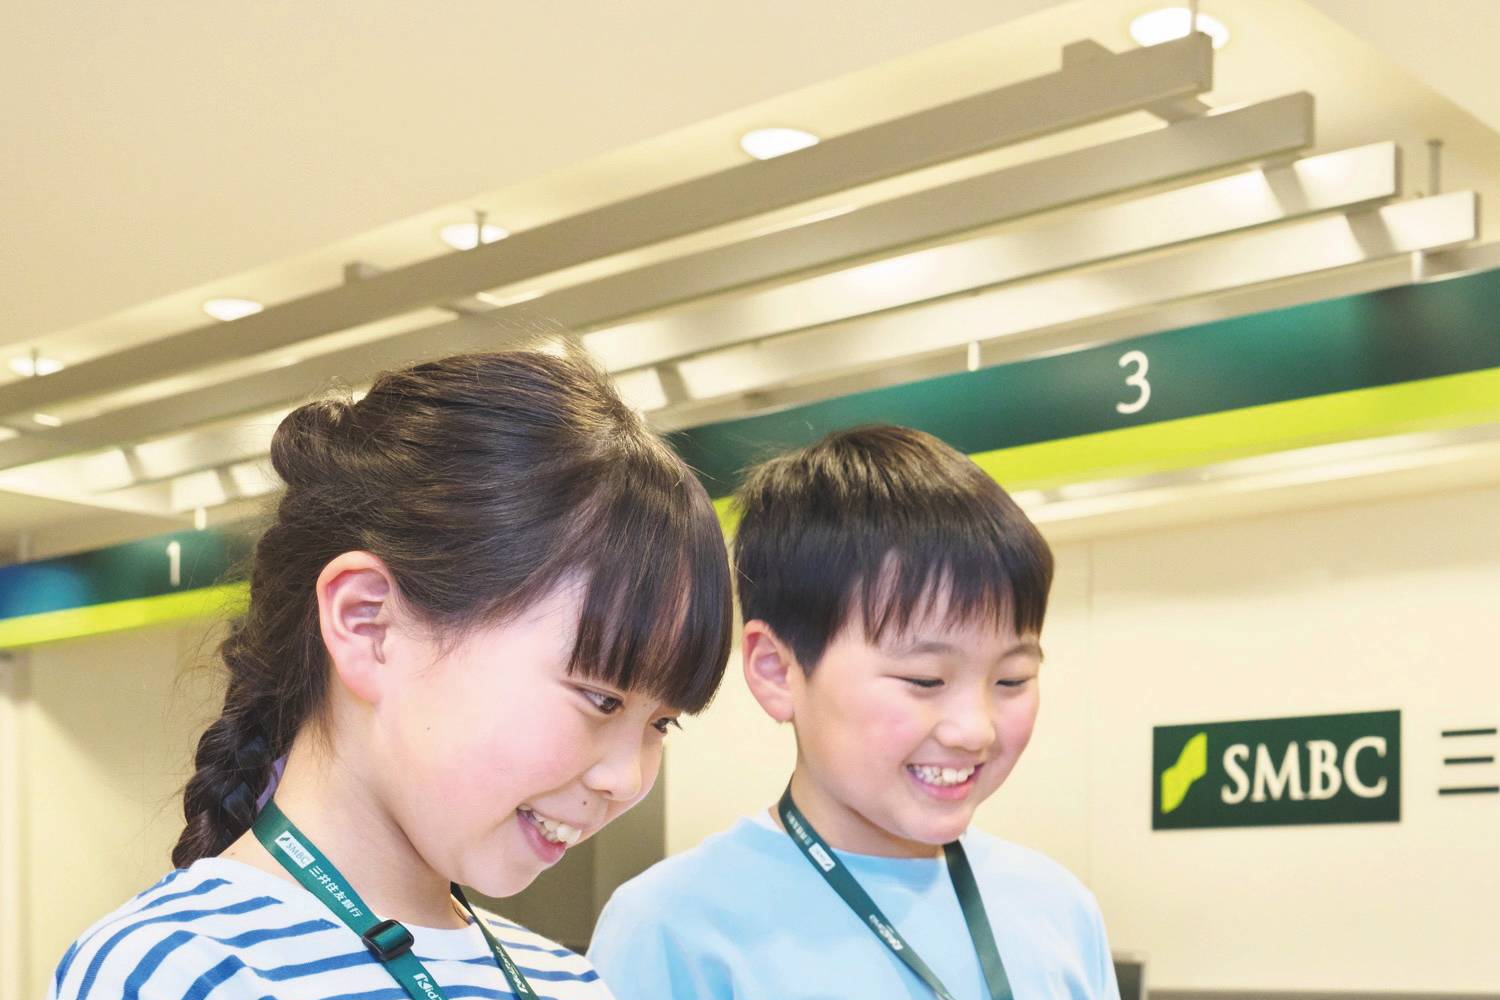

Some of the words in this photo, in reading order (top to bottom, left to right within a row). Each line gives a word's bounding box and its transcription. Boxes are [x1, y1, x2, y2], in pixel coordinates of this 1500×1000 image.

[1115, 350, 1151, 414] 3
[166, 541, 180, 587] 1
[1221, 735, 1388, 804] SMBC
[308, 865, 363, 917] 三井住友銀行
